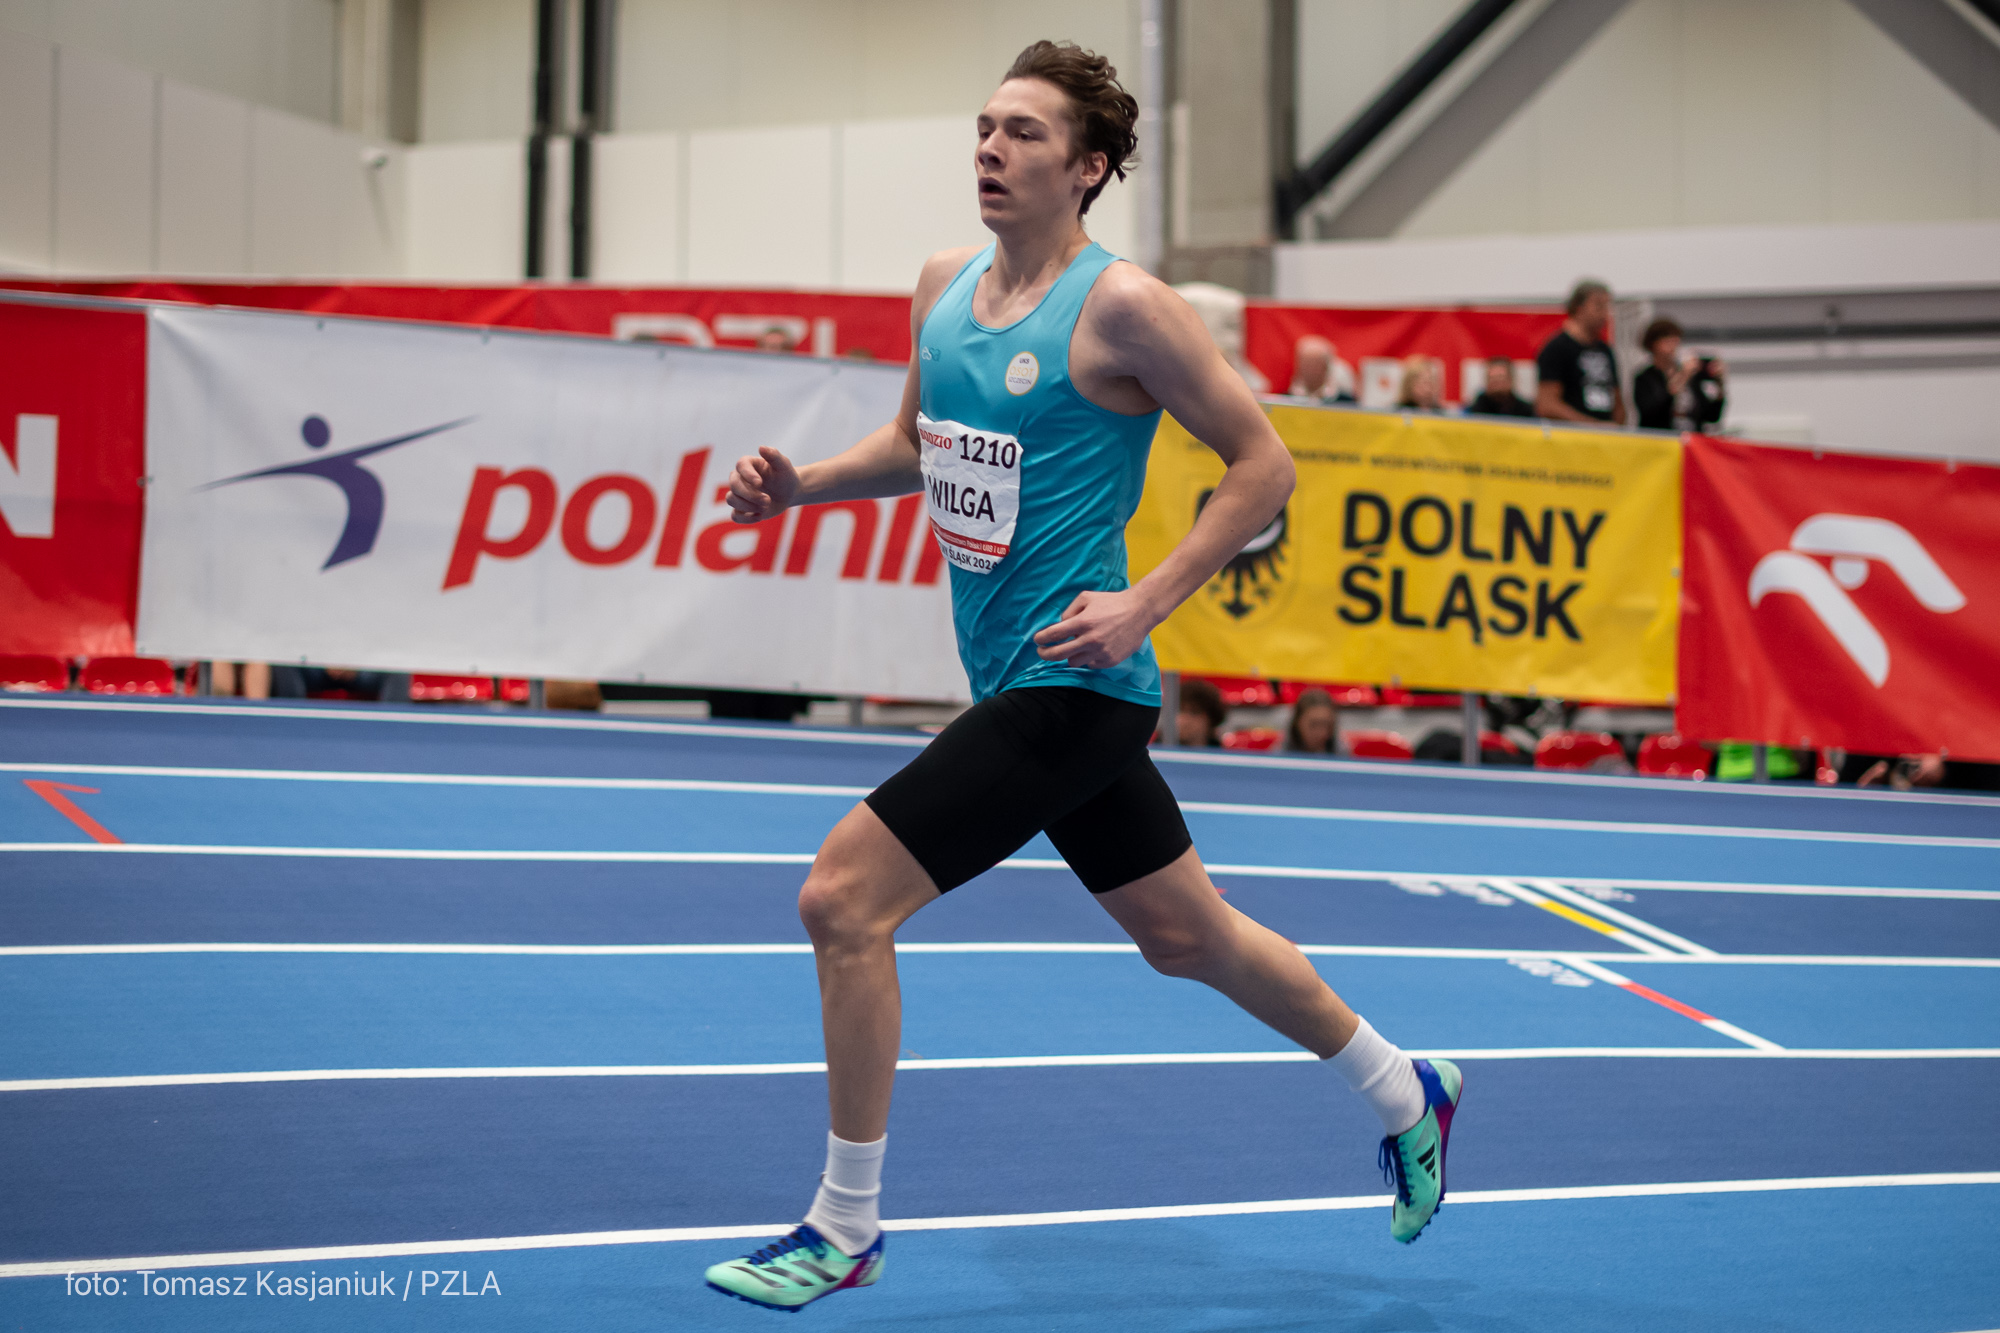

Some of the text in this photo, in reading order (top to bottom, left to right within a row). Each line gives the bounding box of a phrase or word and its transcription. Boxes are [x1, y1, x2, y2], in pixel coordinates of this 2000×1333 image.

[1009, 365, 1035, 377] OSOT
[959, 433, 1017, 470] 1210
[927, 474, 996, 523] WILGA
[1341, 488, 1608, 571] DOLNY
[949, 546, 972, 567] ŚLĄSK
[1334, 543, 1585, 647] ŚLĄSK
